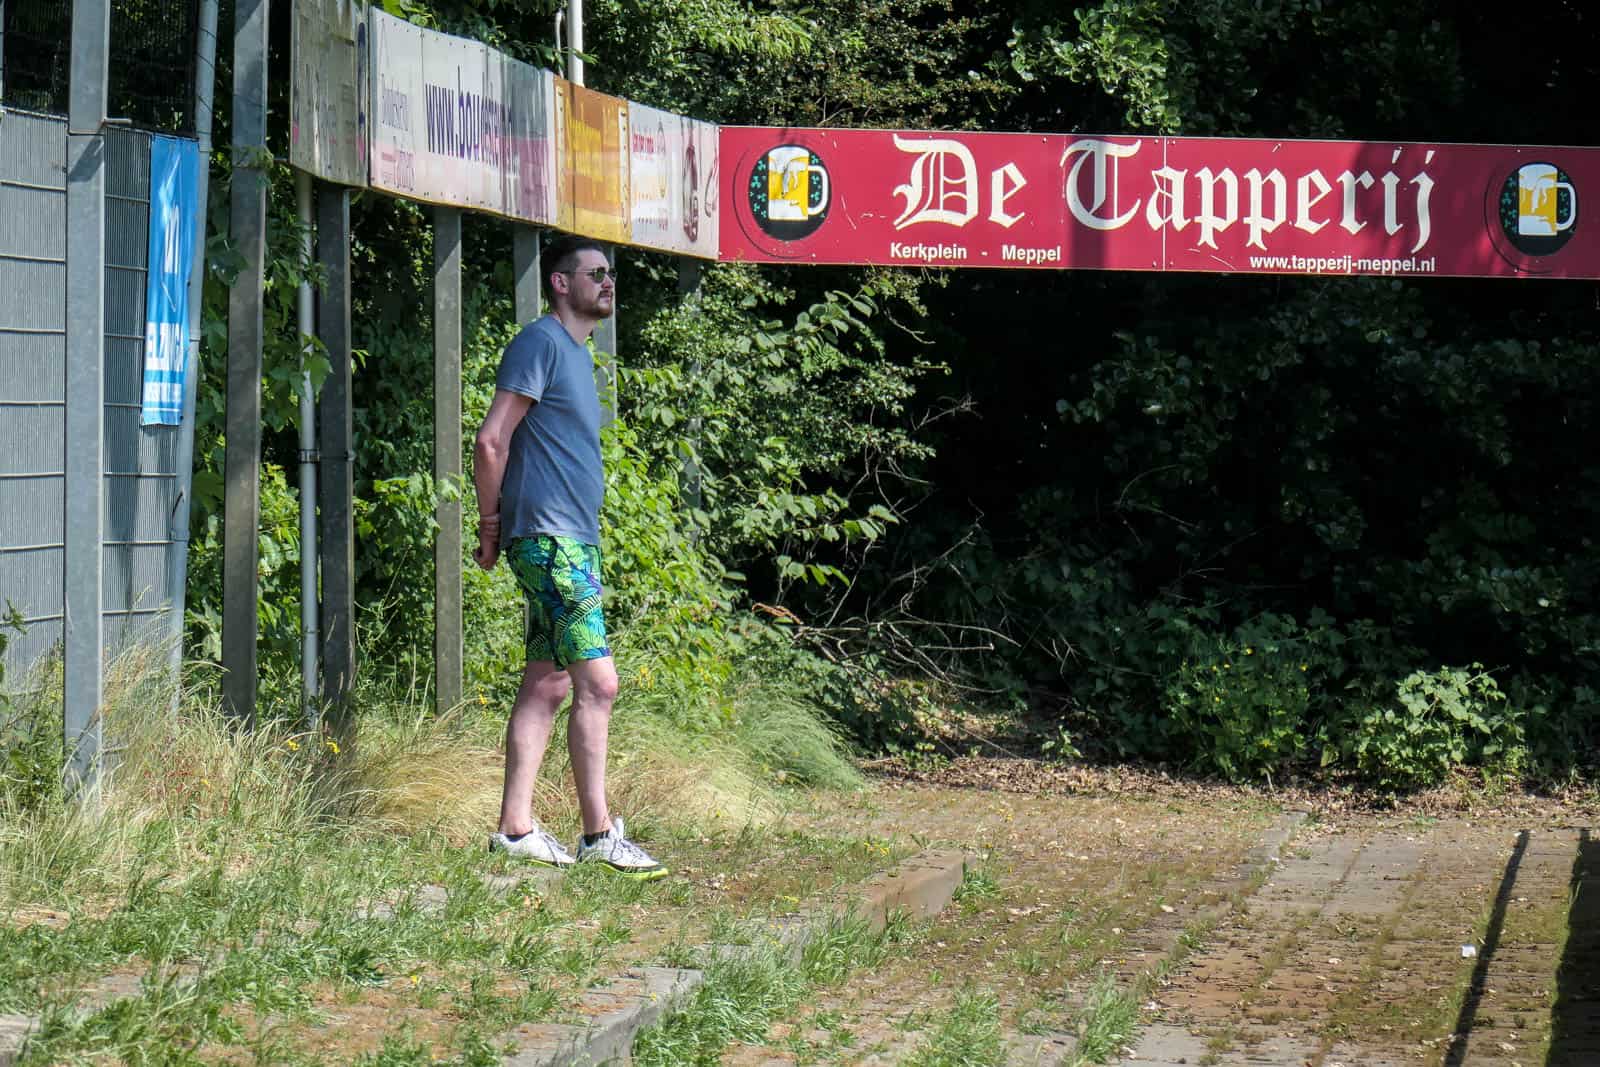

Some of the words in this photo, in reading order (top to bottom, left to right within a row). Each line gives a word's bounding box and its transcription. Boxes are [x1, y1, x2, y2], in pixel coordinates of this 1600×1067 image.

[893, 133, 1027, 230] De
[1059, 139, 1436, 253] Tapperij
[890, 242, 967, 261] Kerkplein
[1002, 245, 1061, 264] Meppel
[1249, 254, 1436, 275] www.tapperij-meppel.nl
